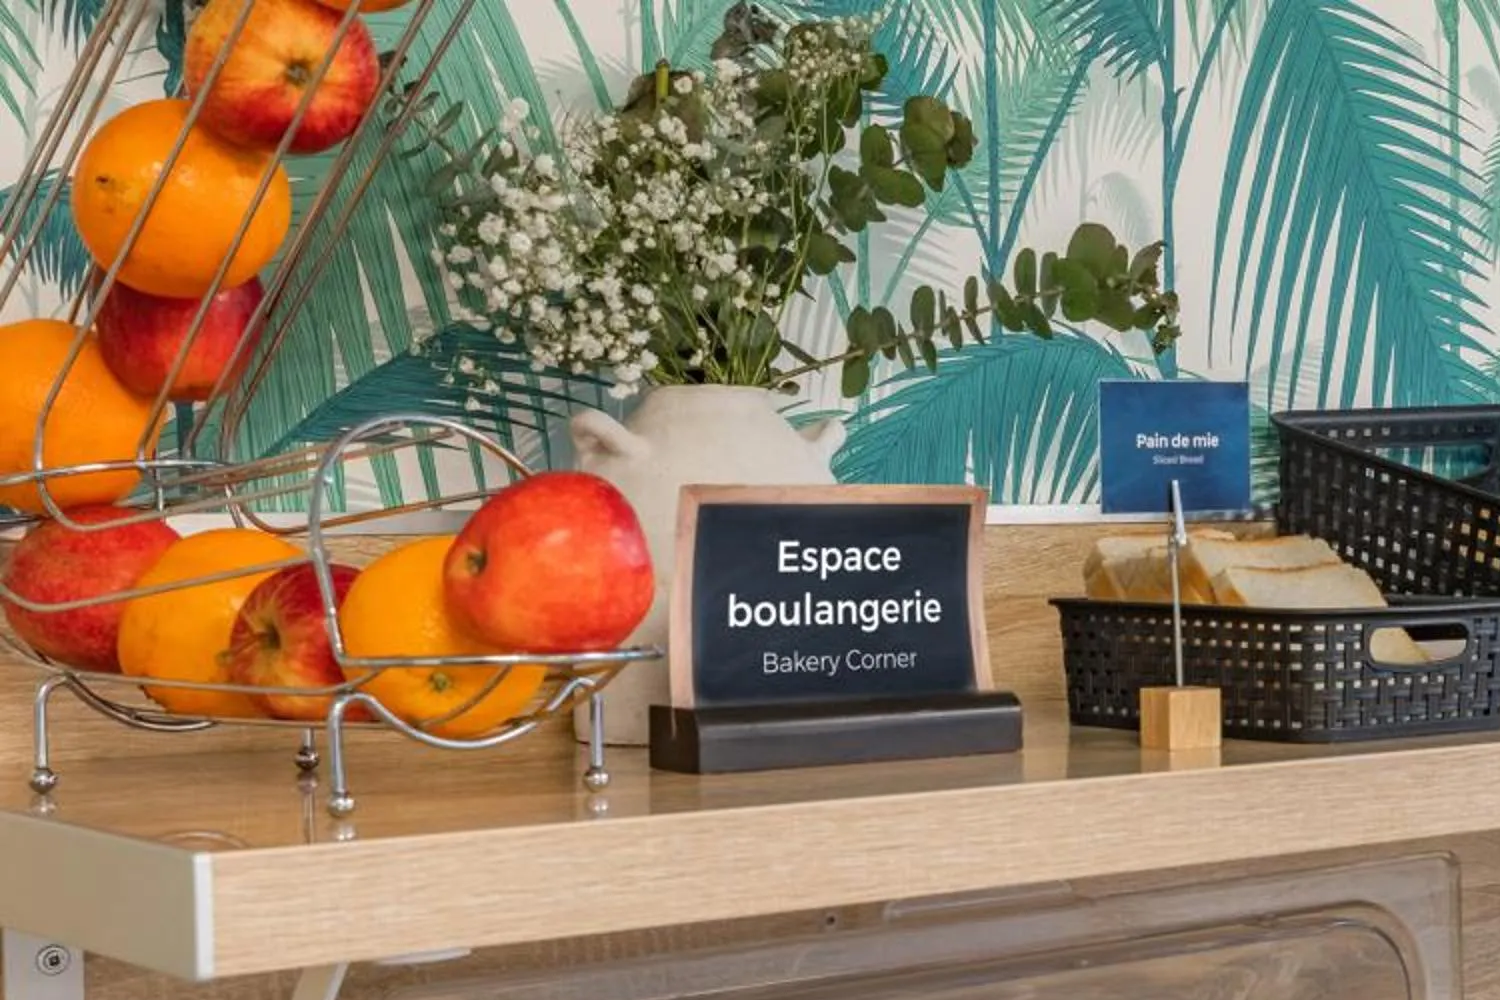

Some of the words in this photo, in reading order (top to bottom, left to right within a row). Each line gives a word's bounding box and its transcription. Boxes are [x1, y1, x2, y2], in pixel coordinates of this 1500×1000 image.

[1135, 431, 1169, 449] Pain
[1171, 433, 1190, 448] de
[1193, 431, 1220, 448] mie
[777, 539, 902, 581] Espace
[727, 589, 943, 633] boulangerie
[762, 651, 841, 677] Bakery
[845, 648, 919, 672] Corner
